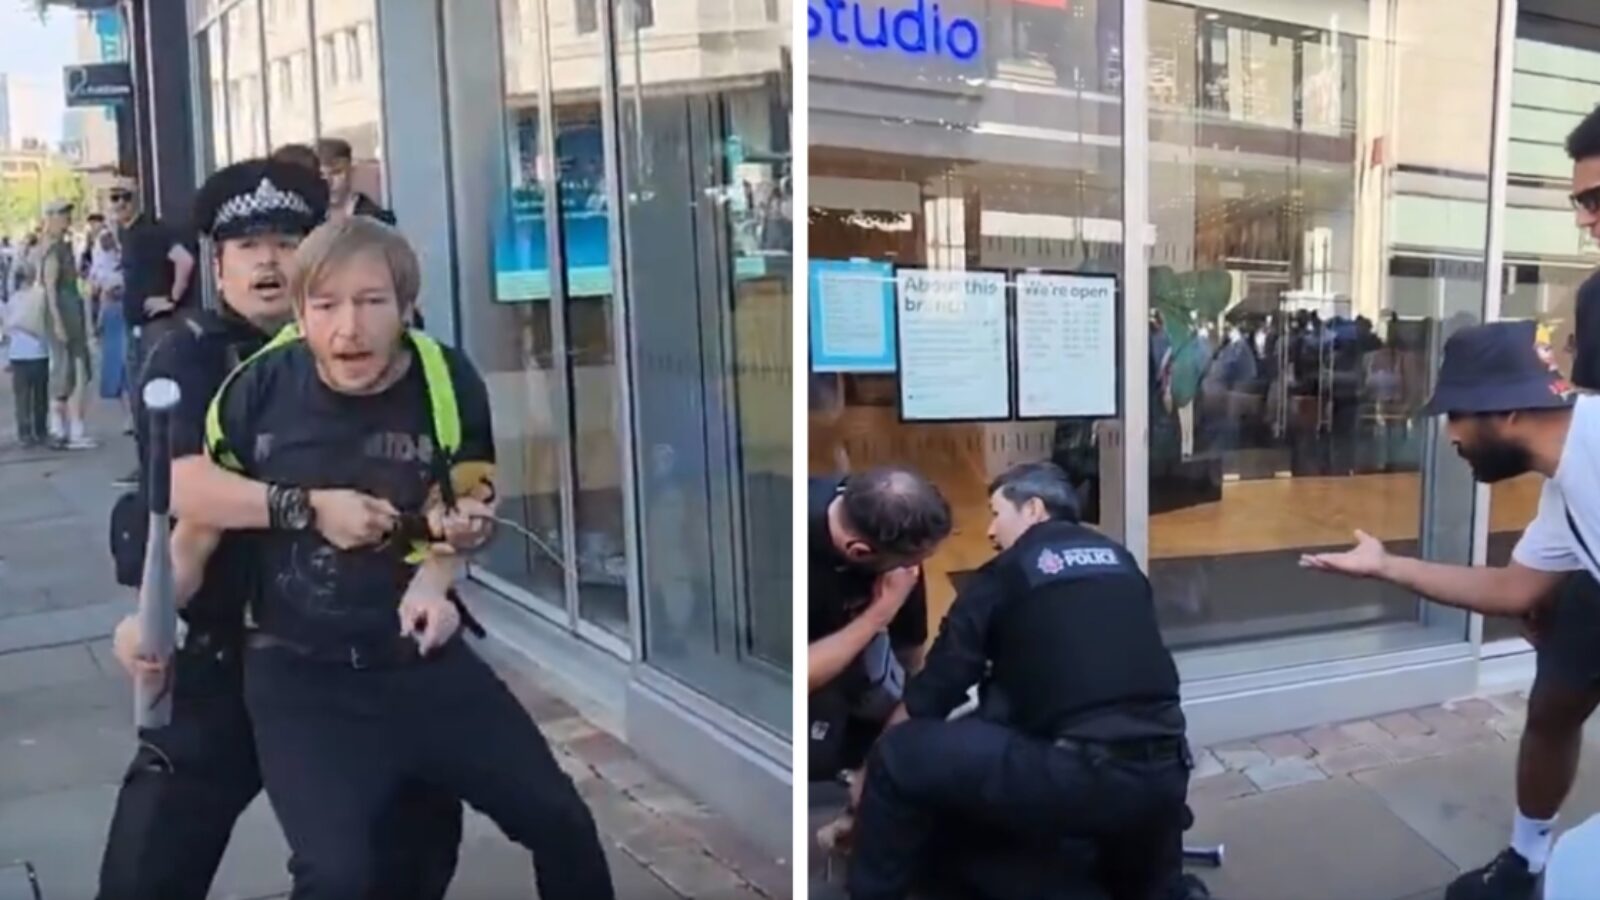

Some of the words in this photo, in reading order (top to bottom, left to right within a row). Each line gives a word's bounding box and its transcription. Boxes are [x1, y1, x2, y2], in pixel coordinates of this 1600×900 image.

[905, 276, 961, 294] About
[964, 278, 998, 296] this
[1024, 281, 1068, 298] We're
[1070, 287, 1108, 302] open
[905, 296, 967, 313] brnch
[1063, 551, 1119, 567] POLICE
